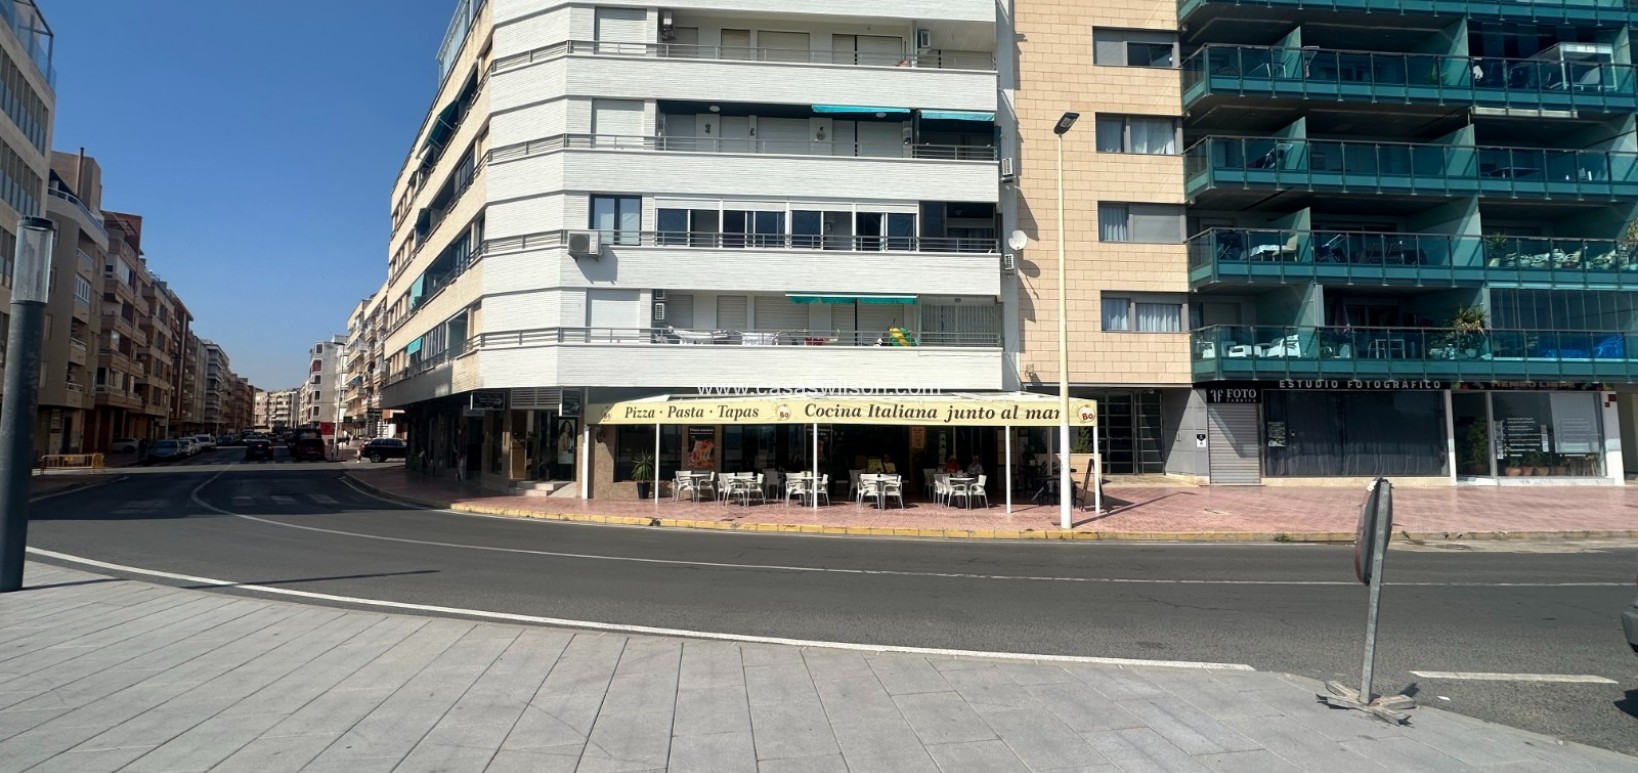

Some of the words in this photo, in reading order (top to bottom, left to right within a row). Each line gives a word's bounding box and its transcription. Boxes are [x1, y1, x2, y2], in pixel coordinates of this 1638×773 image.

[1279, 380, 1339, 389] ESTUDIO
[1226, 388, 1257, 398] FOTO
[624, 406, 655, 419] Pizza
[667, 405, 704, 418] Pasta
[717, 405, 760, 421] Tapas
[804, 403, 862, 418] Cocina
[867, 403, 938, 419] Italiana
[944, 405, 996, 423] junto
[1000, 405, 1019, 420] al
